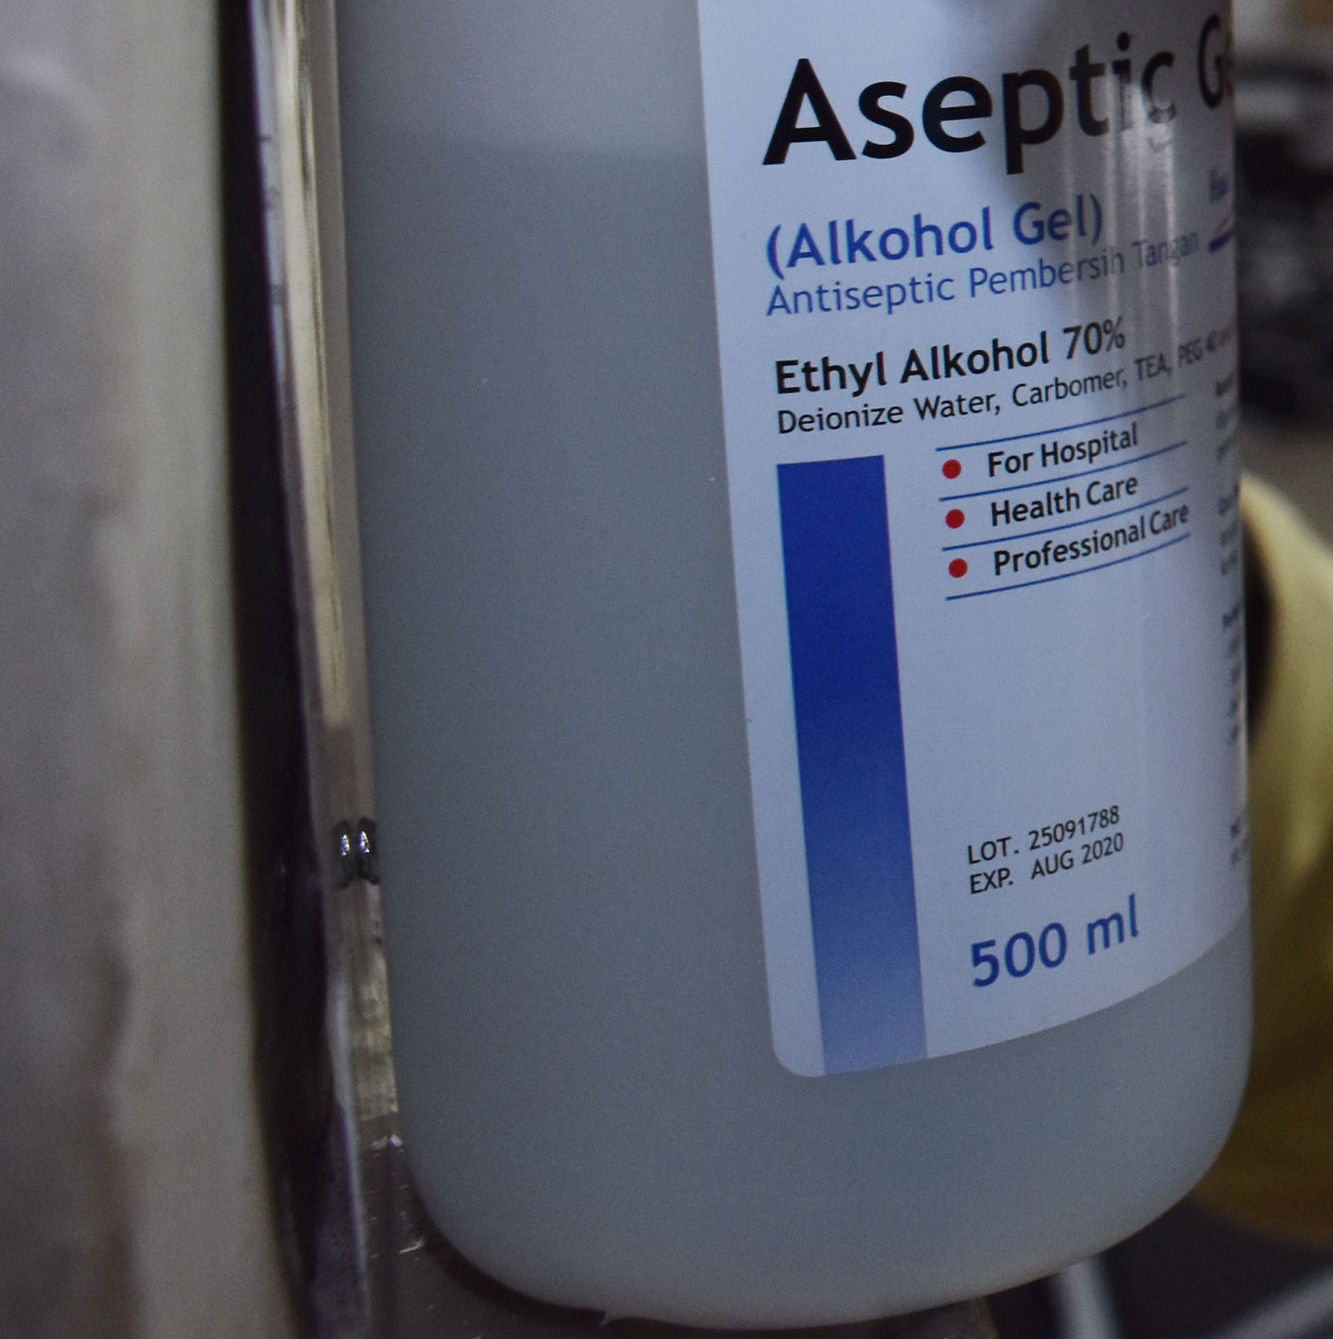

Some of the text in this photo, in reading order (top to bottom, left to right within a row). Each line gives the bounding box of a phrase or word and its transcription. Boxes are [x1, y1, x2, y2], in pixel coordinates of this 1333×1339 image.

[762, 32, 1176, 174] Aseptic
[766, 193, 1102, 281] (Alkohol Gel)
[766, 273, 955, 316] Antiseptic
[970, 239, 1125, 297] Pembersih
[775, 316, 1127, 398] Ethyl Alkohol 70%
[777, 403, 904, 435] Deionize
[914, 392, 1001, 420] Water,
[1012, 367, 1127, 408] Carbomer,
[987, 422, 1139, 478] For Hospital
[991, 474, 1138, 527] Health Care
[994, 516, 1147, 577] Professional
[1150, 503, 1189, 535] Care
[967, 805, 1121, 865] LOT. 25091788
[970, 832, 1124, 895] EXP. AUG 2020
[971, 892, 1139, 987] 500 ml
